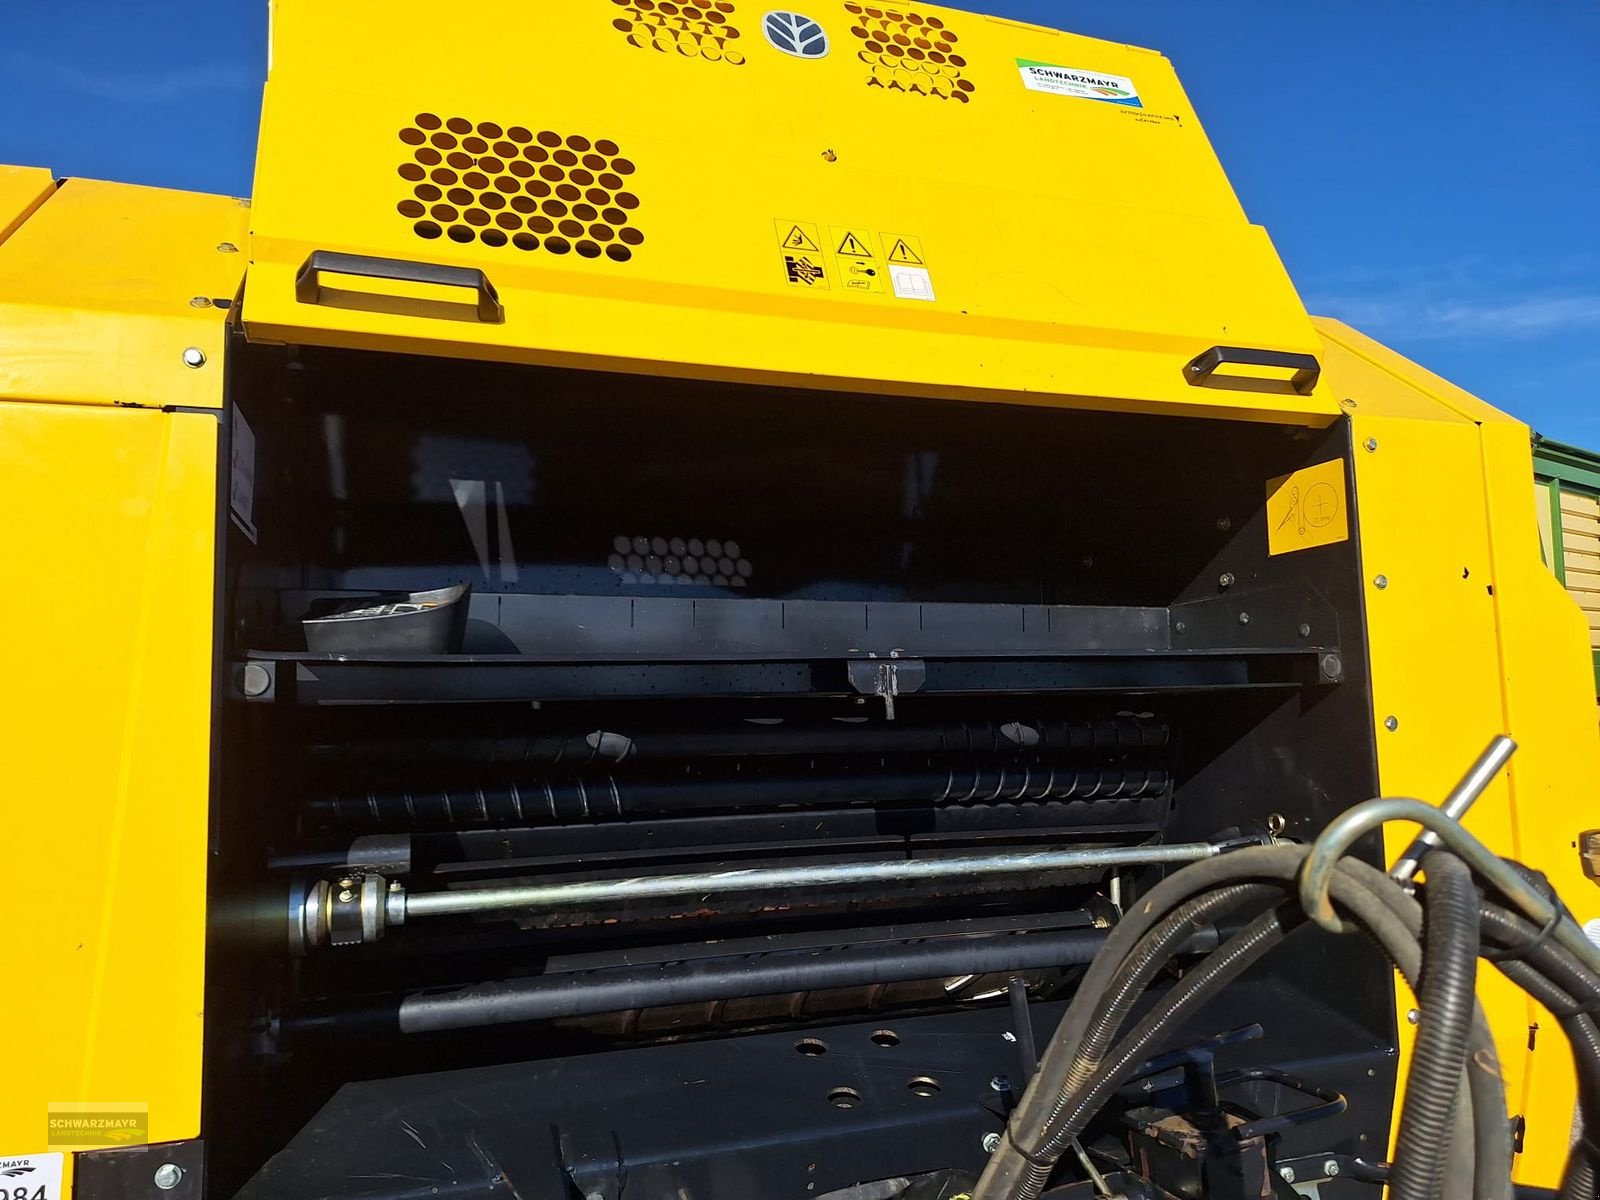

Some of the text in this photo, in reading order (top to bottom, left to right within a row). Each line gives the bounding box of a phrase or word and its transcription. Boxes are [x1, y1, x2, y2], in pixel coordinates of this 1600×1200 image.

[1029, 67, 1119, 88] SCHWARZMAYR
[1034, 76, 1088, 89] LANDTECHNIK
[0, 1159, 30, 1169] MAYR
